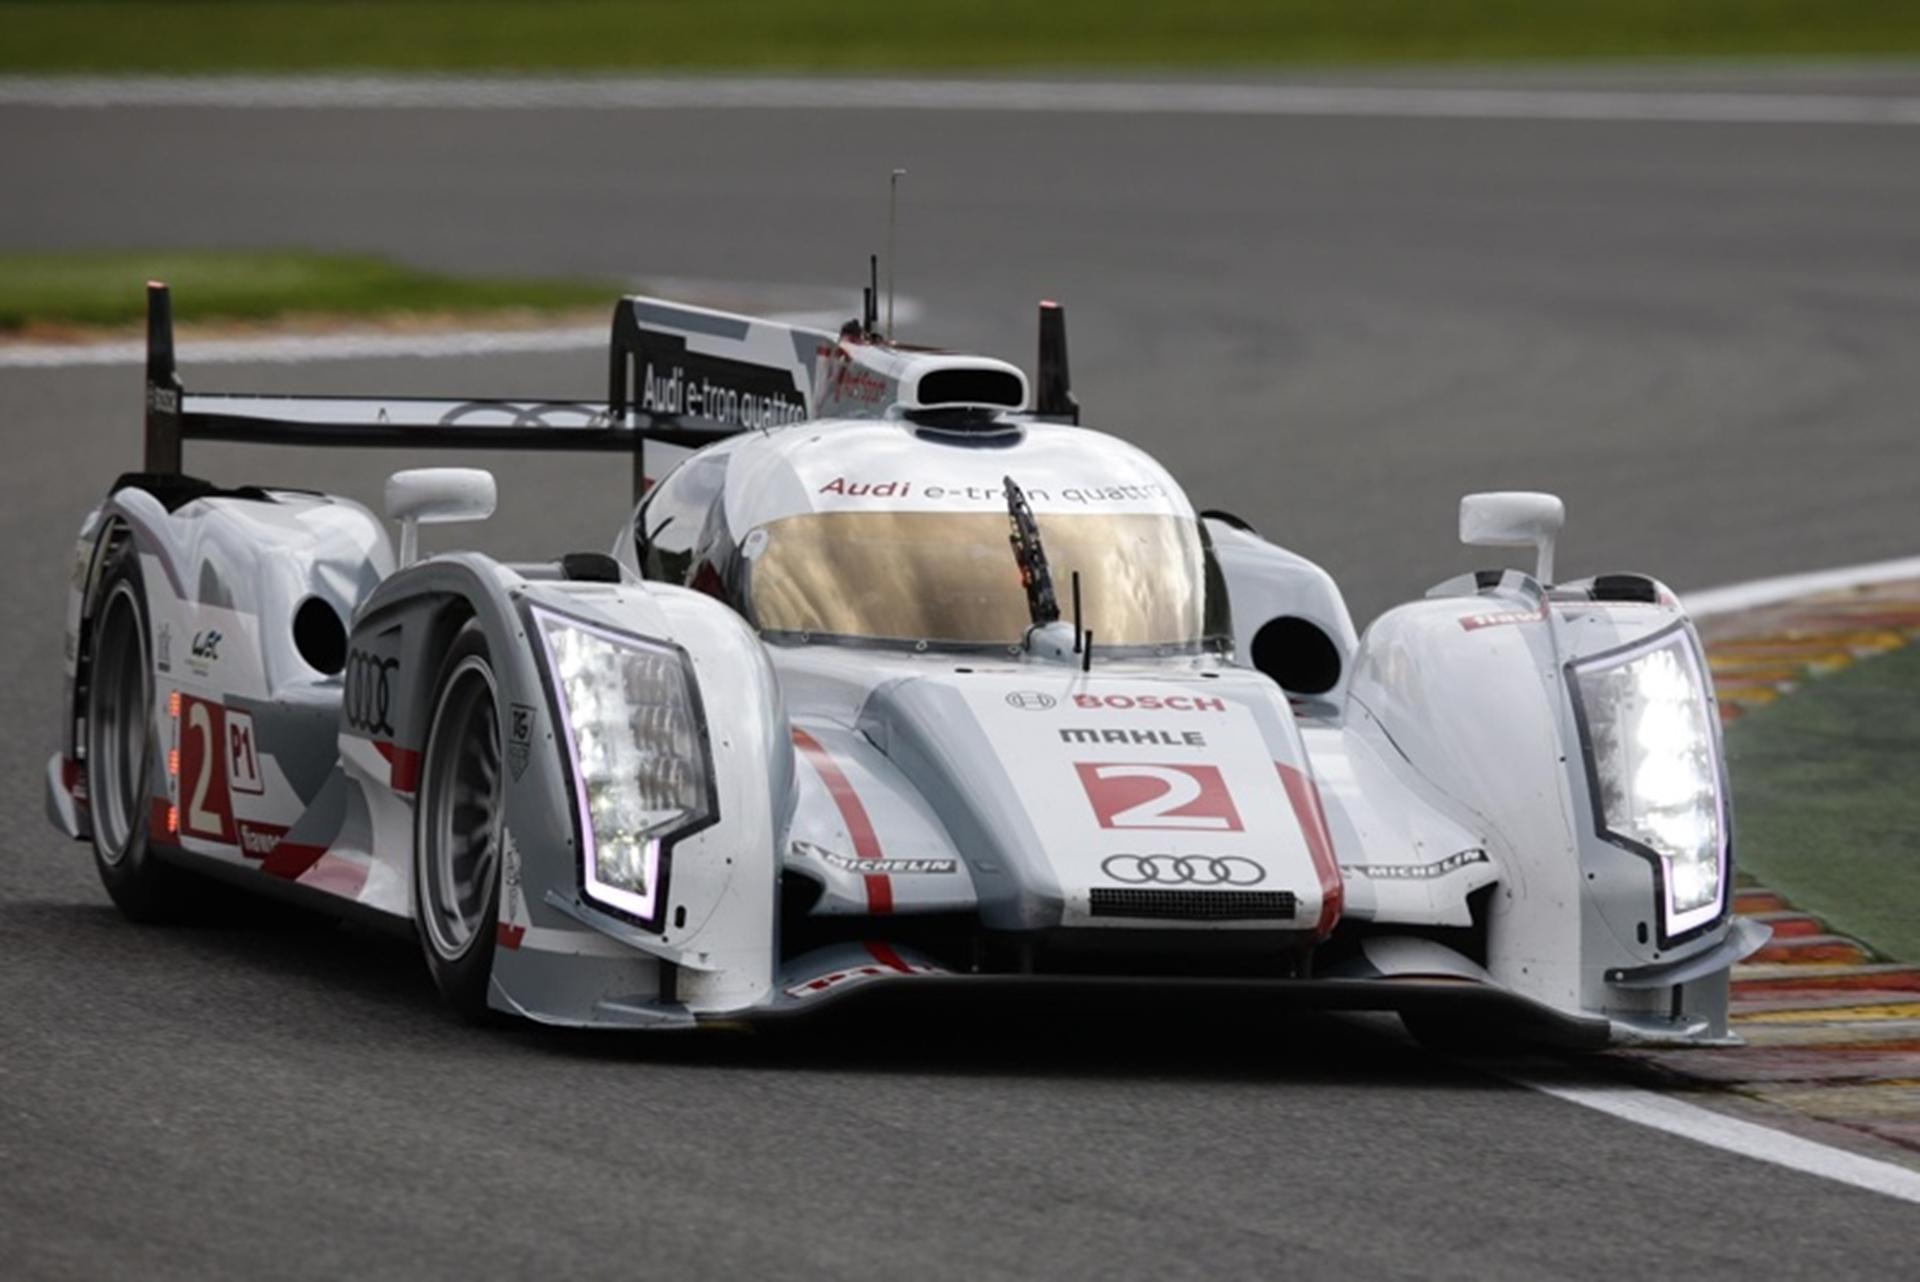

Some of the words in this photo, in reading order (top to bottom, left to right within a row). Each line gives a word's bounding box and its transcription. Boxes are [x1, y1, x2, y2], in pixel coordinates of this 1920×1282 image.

[643, 362, 684, 414] Audi
[686, 377, 738, 425] e-tron
[819, 477, 911, 498] Audi
[923, 486, 1050, 501] e-trn
[1073, 694, 1226, 712] BOSCH
[231, 722, 255, 780] P1
[1058, 728, 1206, 747] MAHLE
[189, 702, 223, 835] 2
[1095, 765, 1231, 829] 2
[824, 852, 951, 872] MICHELIN
[1367, 850, 1481, 879] MICHELIN
